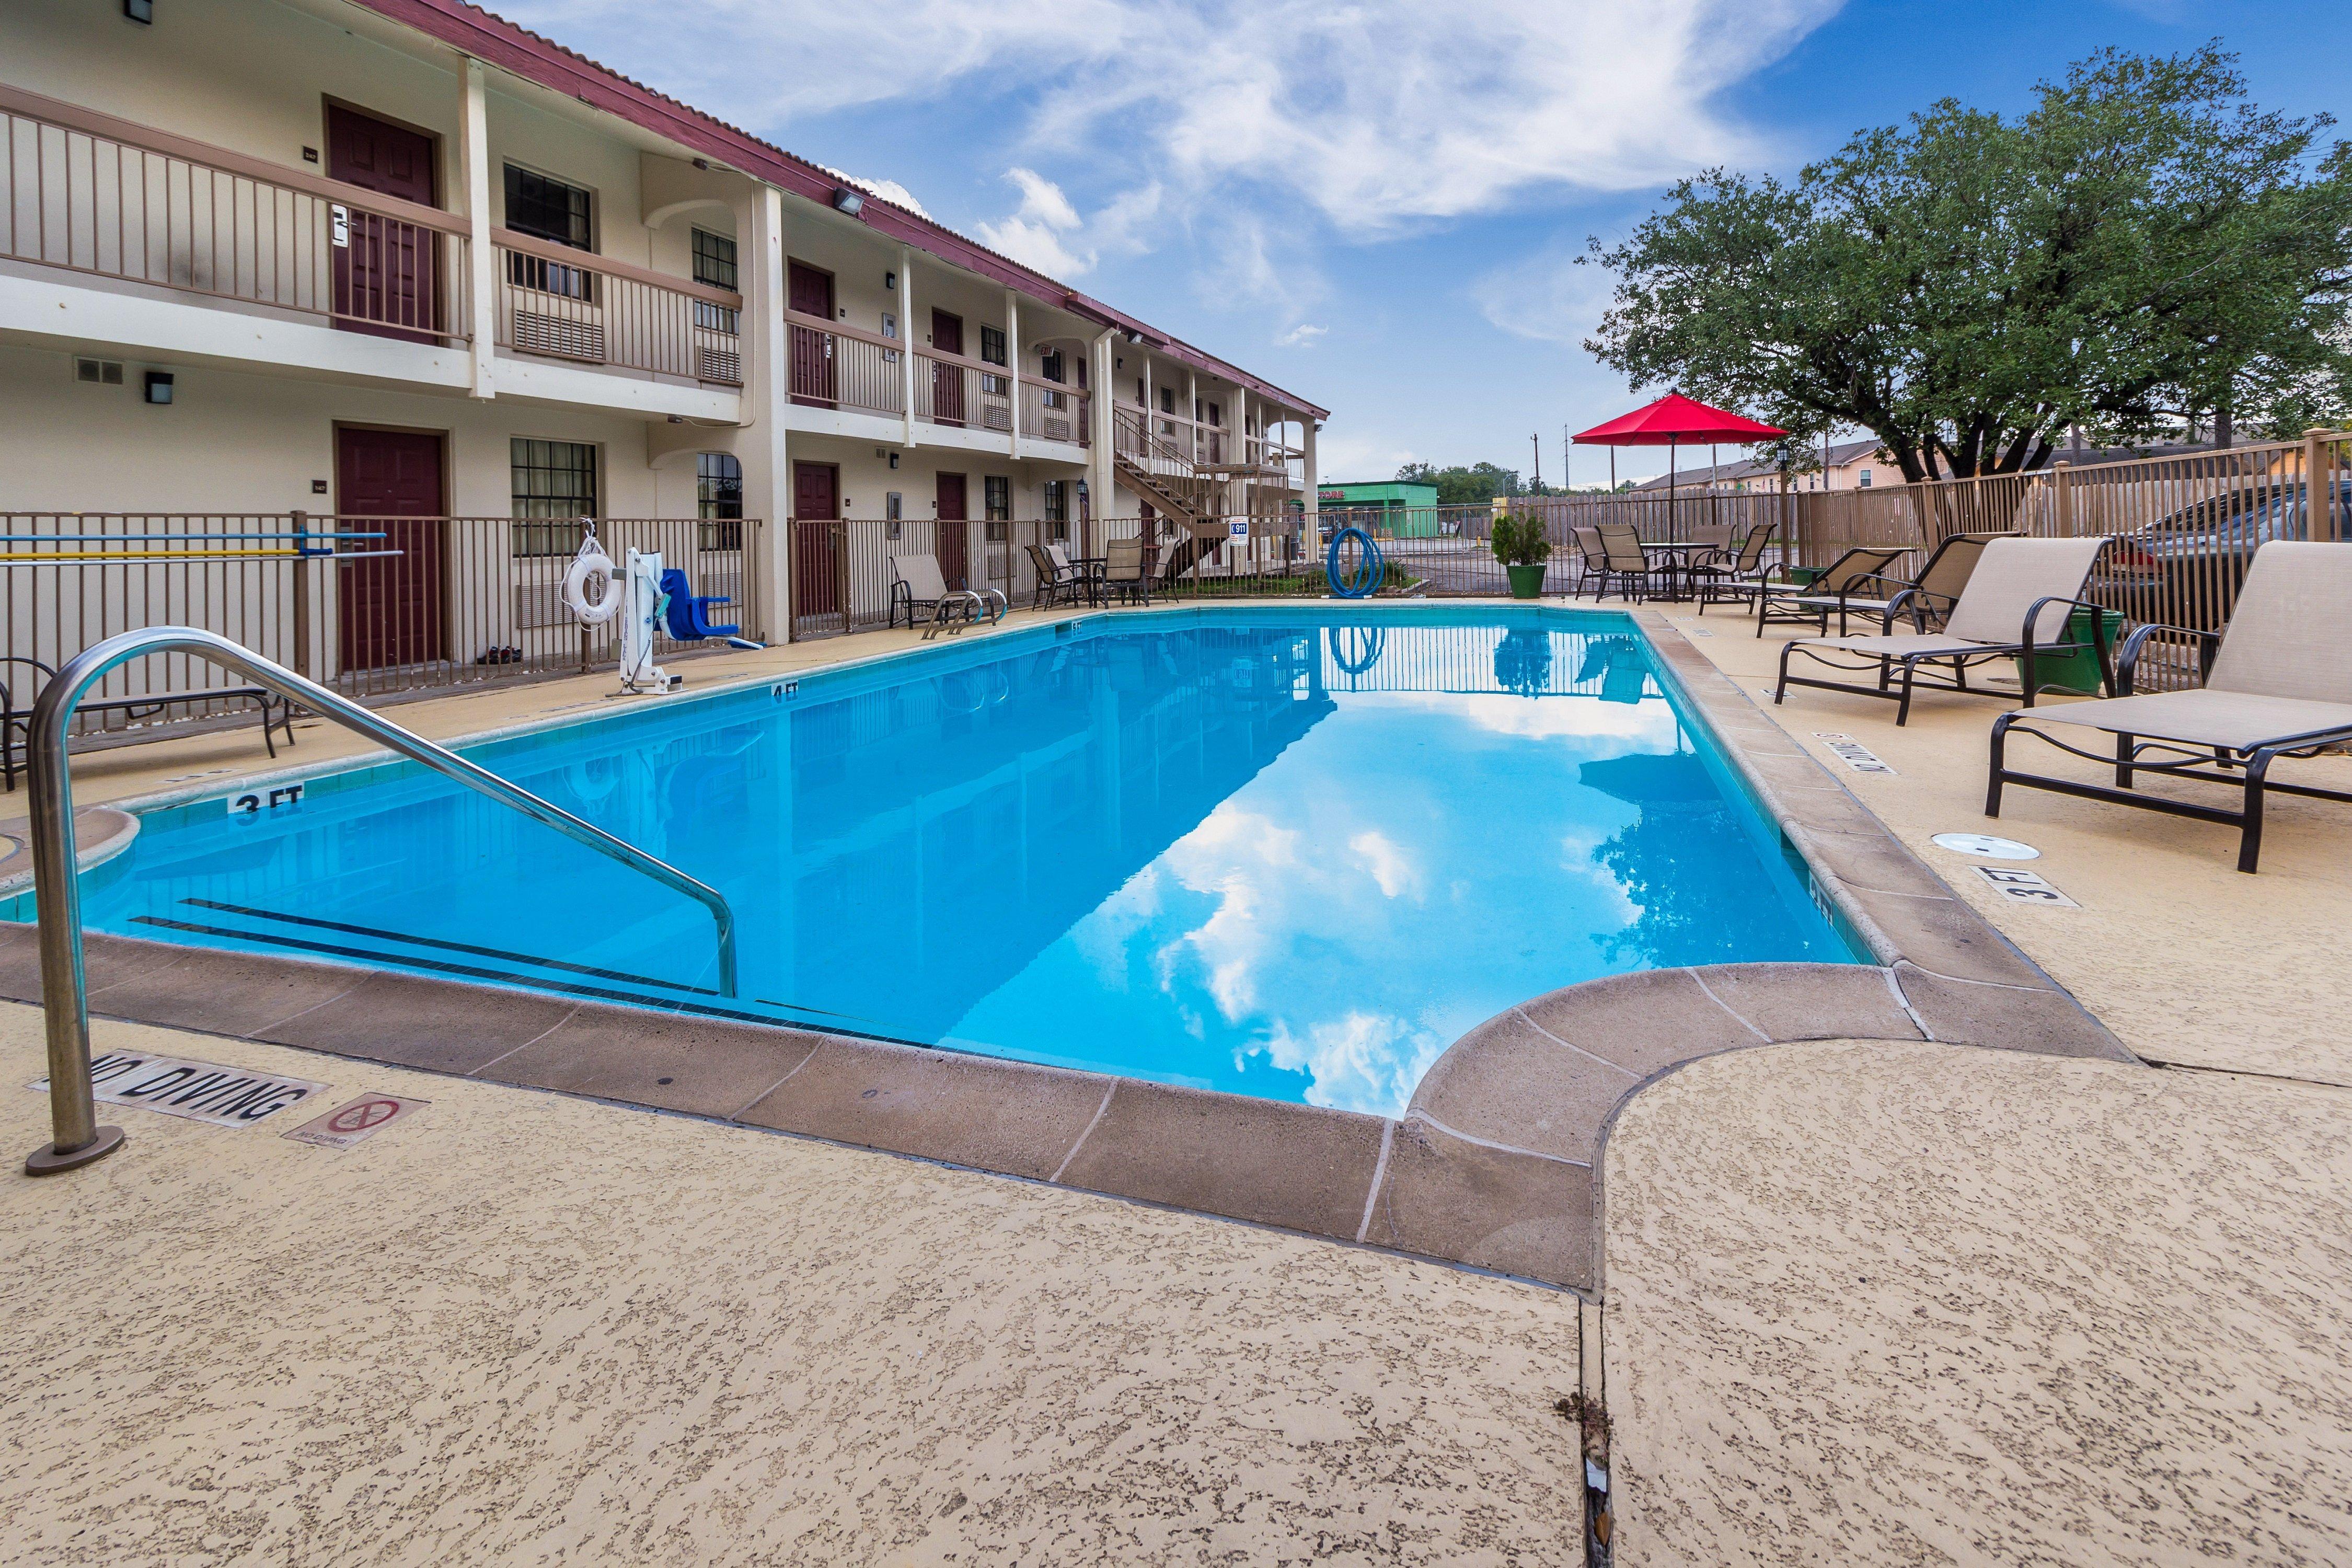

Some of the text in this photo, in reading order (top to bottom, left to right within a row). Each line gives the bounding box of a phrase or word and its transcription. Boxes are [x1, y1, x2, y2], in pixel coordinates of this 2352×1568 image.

[1236, 524, 1246, 533] 911
[786, 682, 798, 696] FT
[1829, 743, 1892, 774] NO DIVING
[235, 785, 303, 820] 3 FT
[1978, 867, 2058, 900] 3 FT
[118, 1067, 308, 1121] DIVING
[313, 1134, 347, 1144] DIVING
